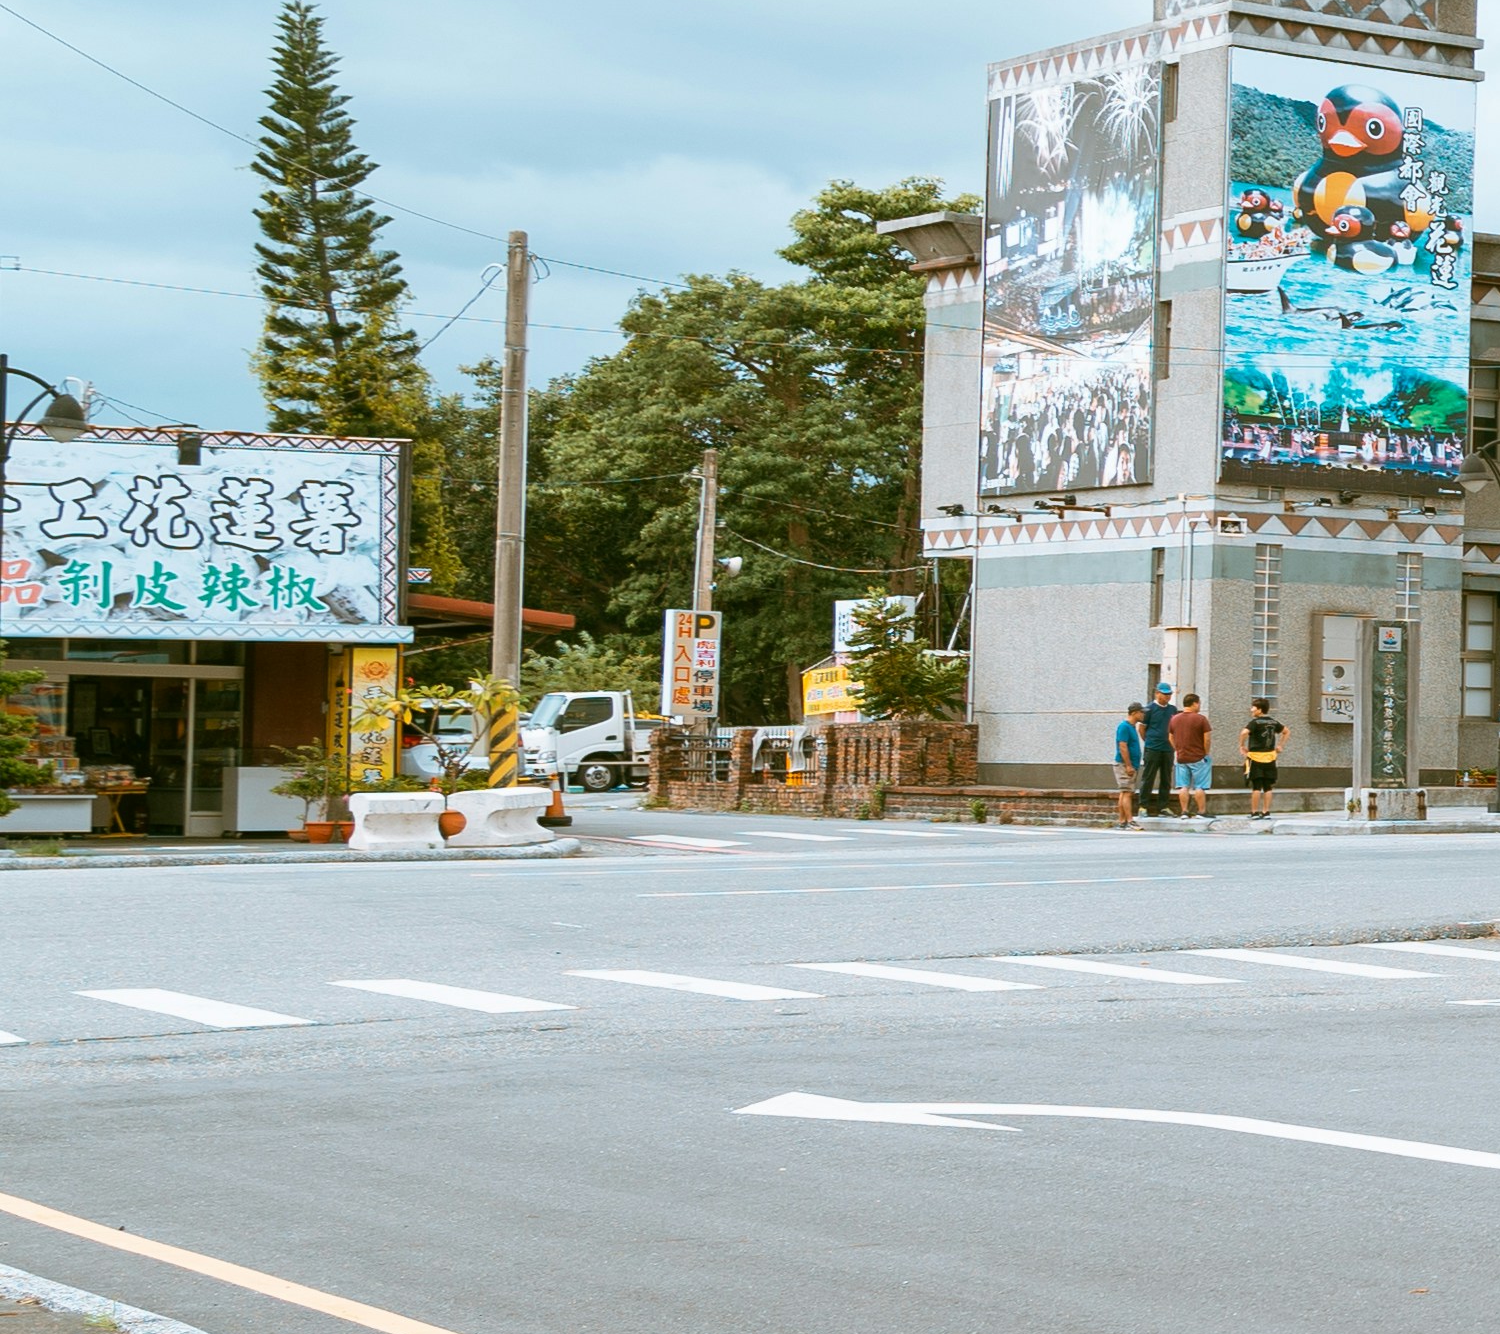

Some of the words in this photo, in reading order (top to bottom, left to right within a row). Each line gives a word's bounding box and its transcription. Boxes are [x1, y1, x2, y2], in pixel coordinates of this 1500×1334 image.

[1398, 107, 1426, 212] 國際都會
[1425, 171, 1459, 290] 觀光花蓮
[0, 474, 362, 555] 工花蓮薯
[694, 614, 716, 639] P
[693, 670, 716, 714] 停車場
